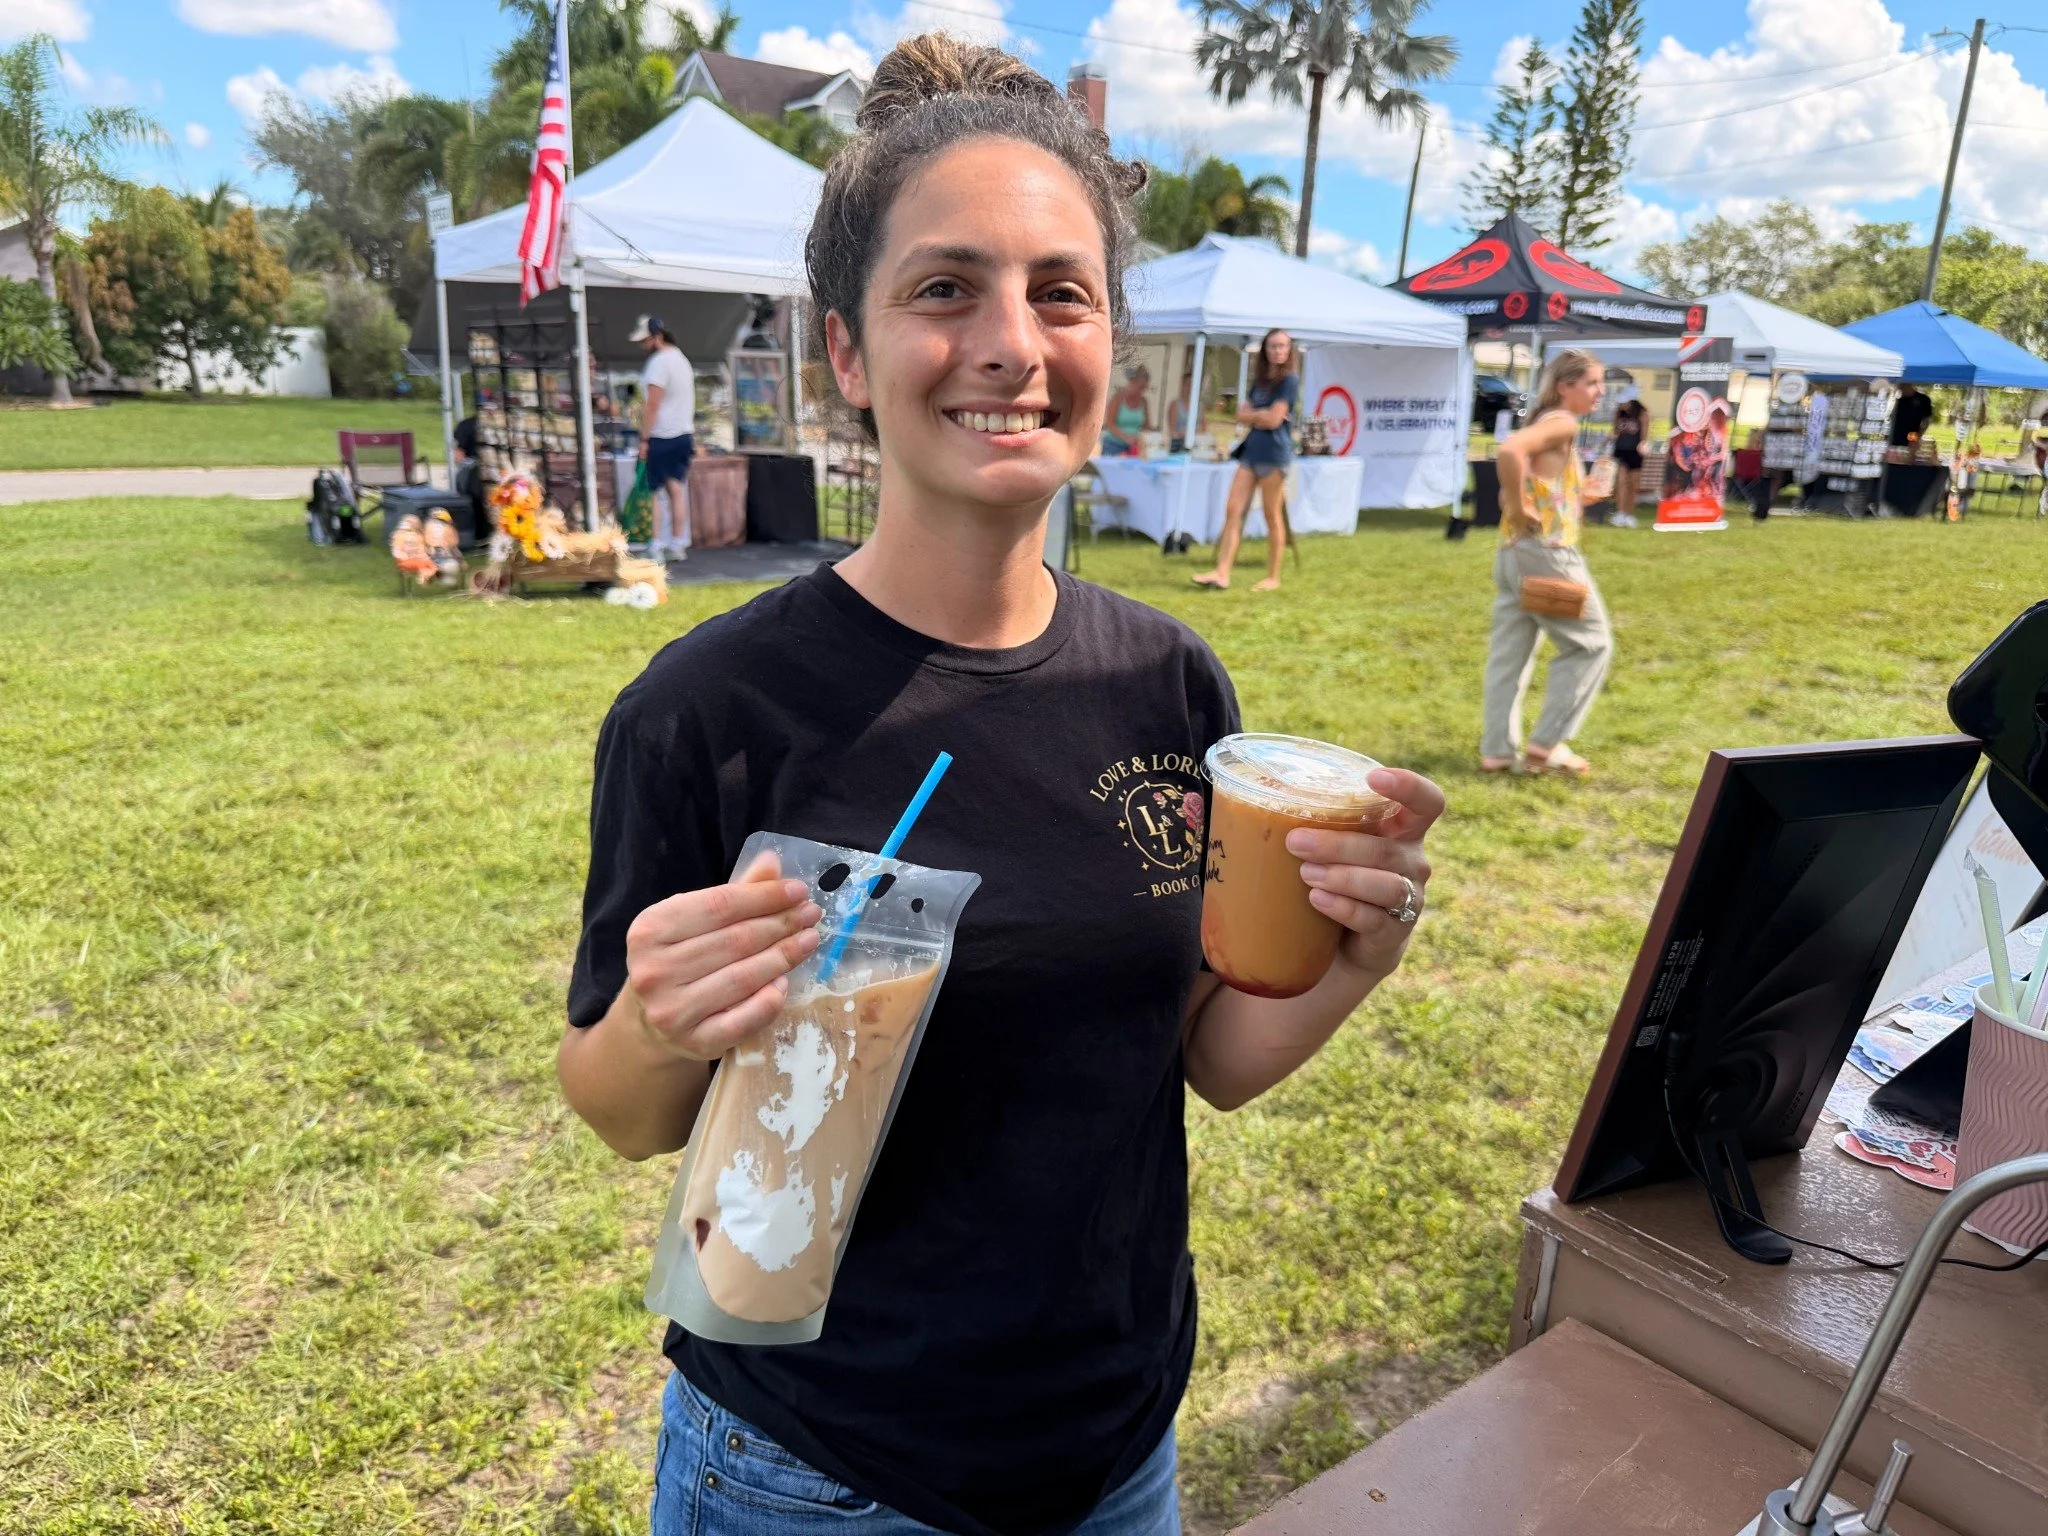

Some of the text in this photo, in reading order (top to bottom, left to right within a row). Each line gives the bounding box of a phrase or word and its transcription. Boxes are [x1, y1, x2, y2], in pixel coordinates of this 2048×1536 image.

[1364, 398, 1405, 412] WHERE
[1408, 399, 1446, 412] SWEAT
[1376, 418, 1456, 432] CELEBRATION
[1090, 761, 1130, 802] LOVE
[1131, 757, 1148, 773] &
[1150, 877, 1190, 897] BOOK
